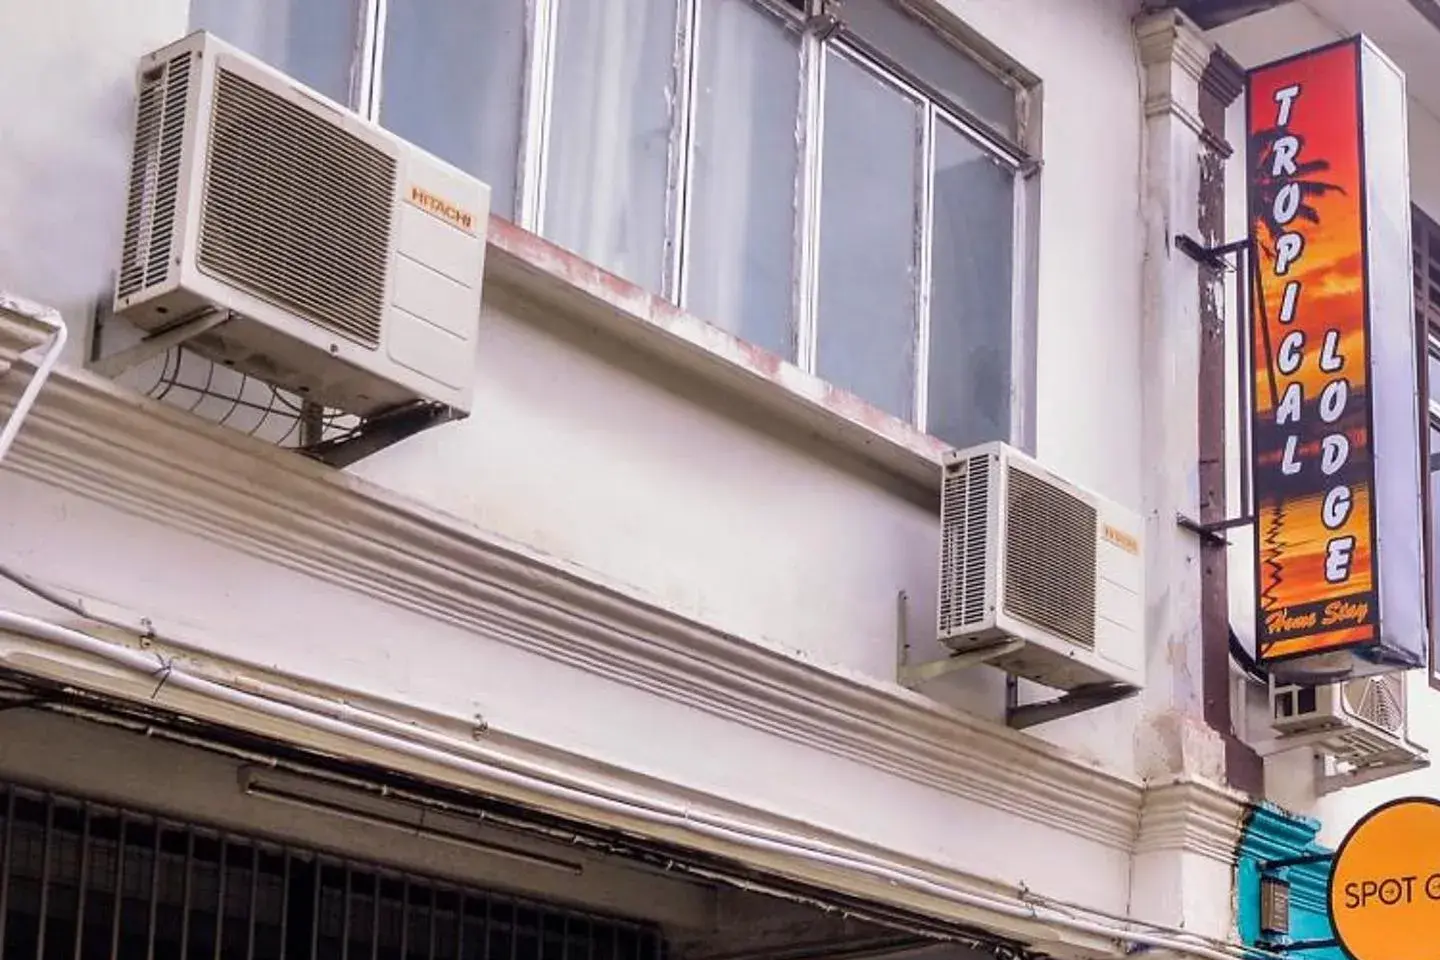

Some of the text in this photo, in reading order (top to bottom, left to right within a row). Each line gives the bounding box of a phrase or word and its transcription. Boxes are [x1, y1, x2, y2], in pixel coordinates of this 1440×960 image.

[1271, 84, 1306, 478] TROPICAL
[1318, 328, 1356, 584] LODGE
[1344, 876, 1417, 909] SPOT
